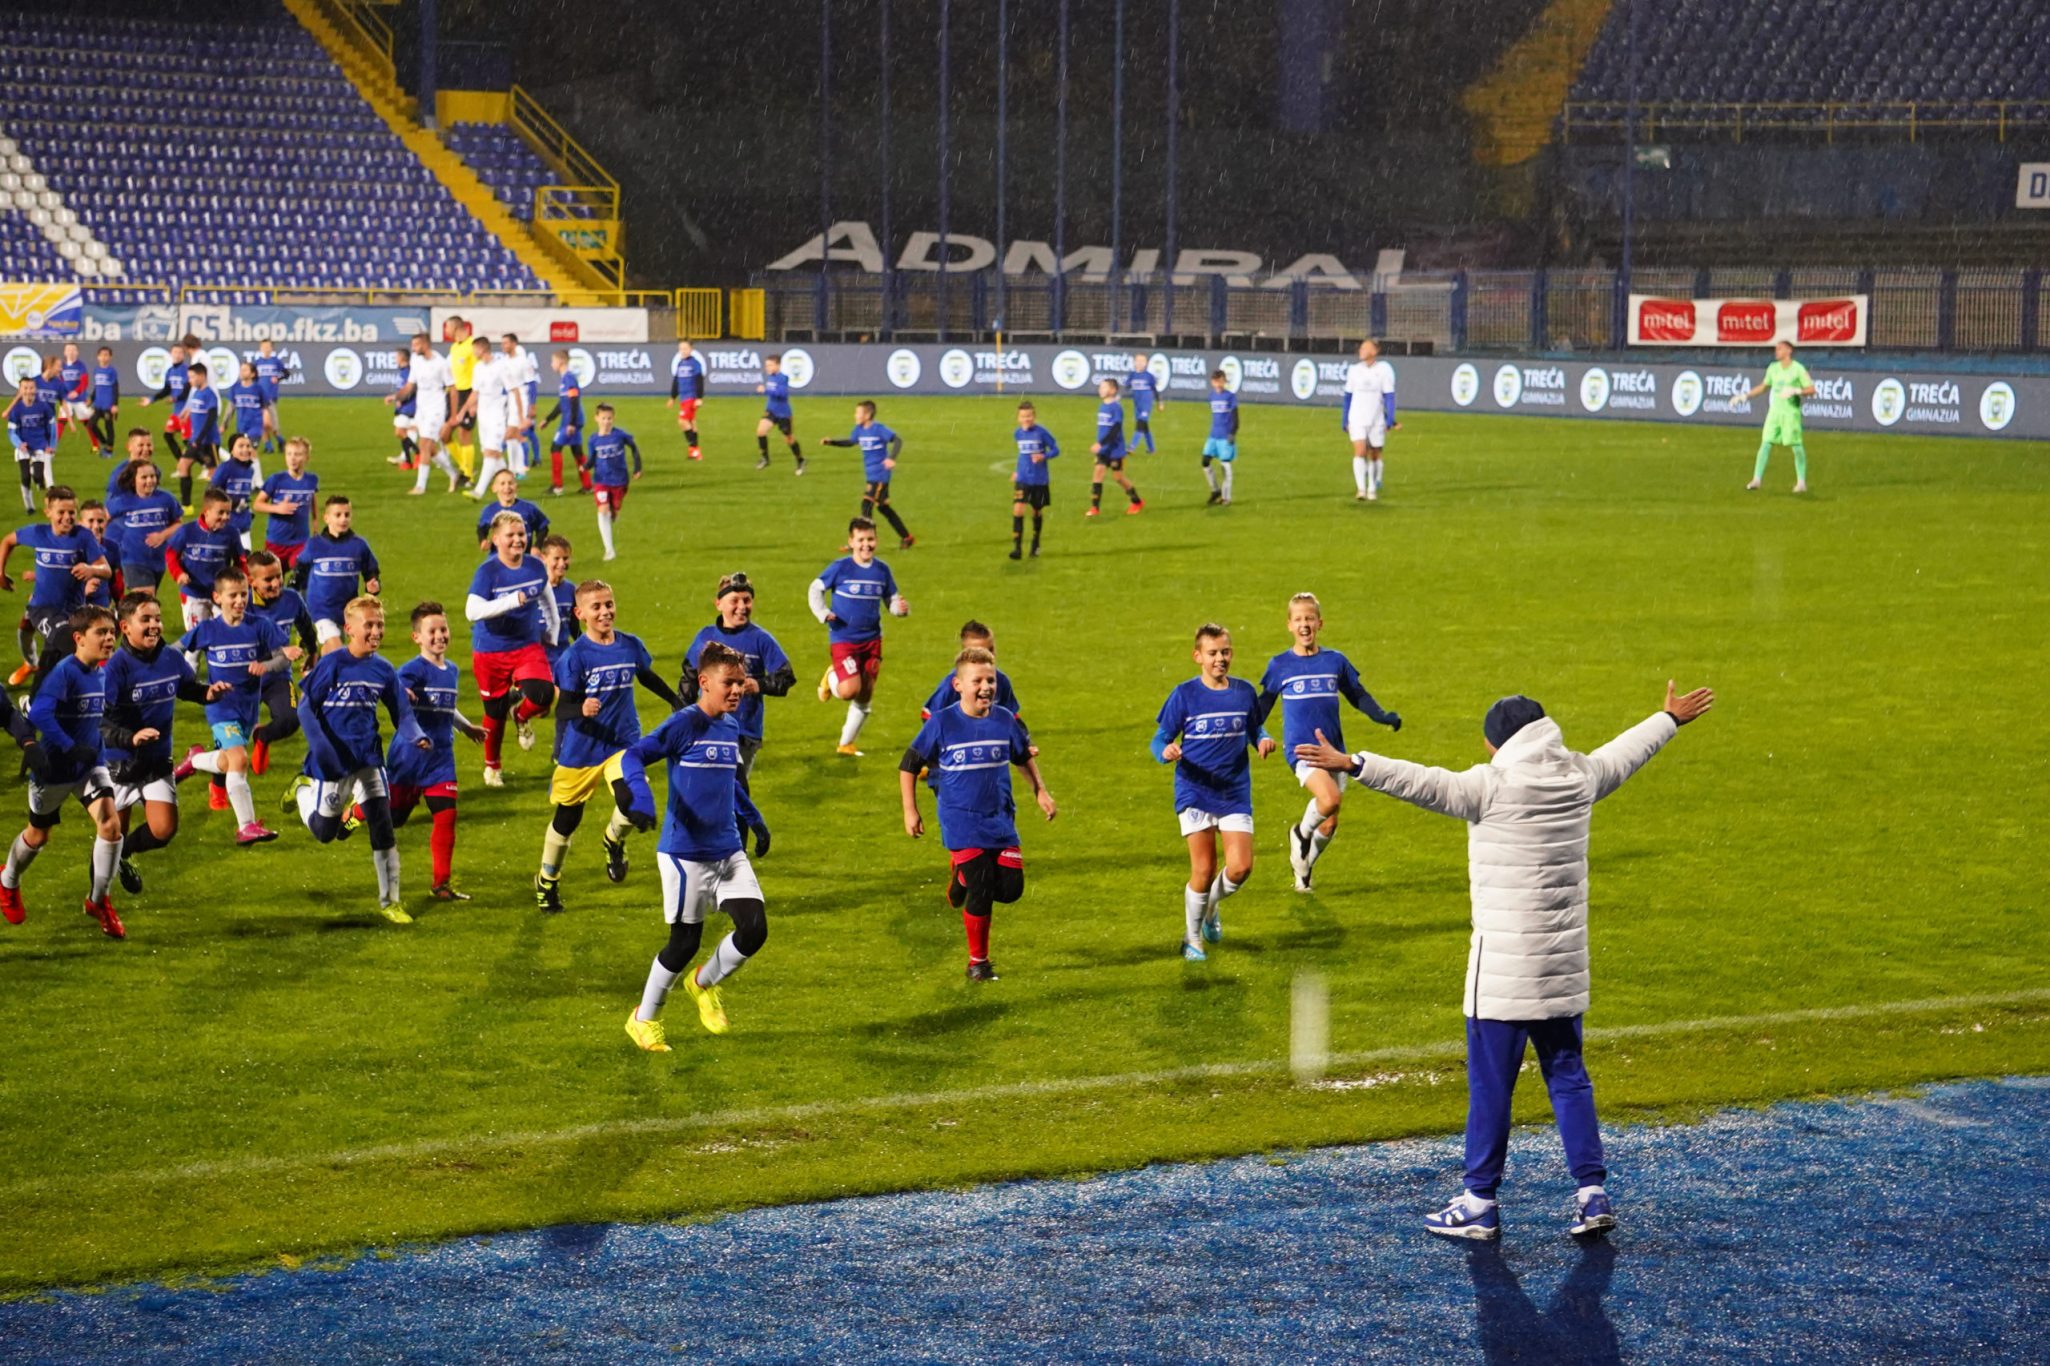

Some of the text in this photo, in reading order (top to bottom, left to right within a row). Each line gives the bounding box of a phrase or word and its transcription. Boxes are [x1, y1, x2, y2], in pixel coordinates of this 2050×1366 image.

[2030, 172, 2050, 198] D
[766, 221, 1456, 293] ADMIRAL
[365, 351, 398, 369] TRE
[597, 348, 652, 369] TREĆA
[708, 349, 761, 369] TREĆA
[1523, 366, 1565, 389] TREĆA
[1612, 369, 1656, 393] TREĆA
[1807, 376, 1853, 400] REĆA
[1909, 379, 1960, 405] TREĆA
